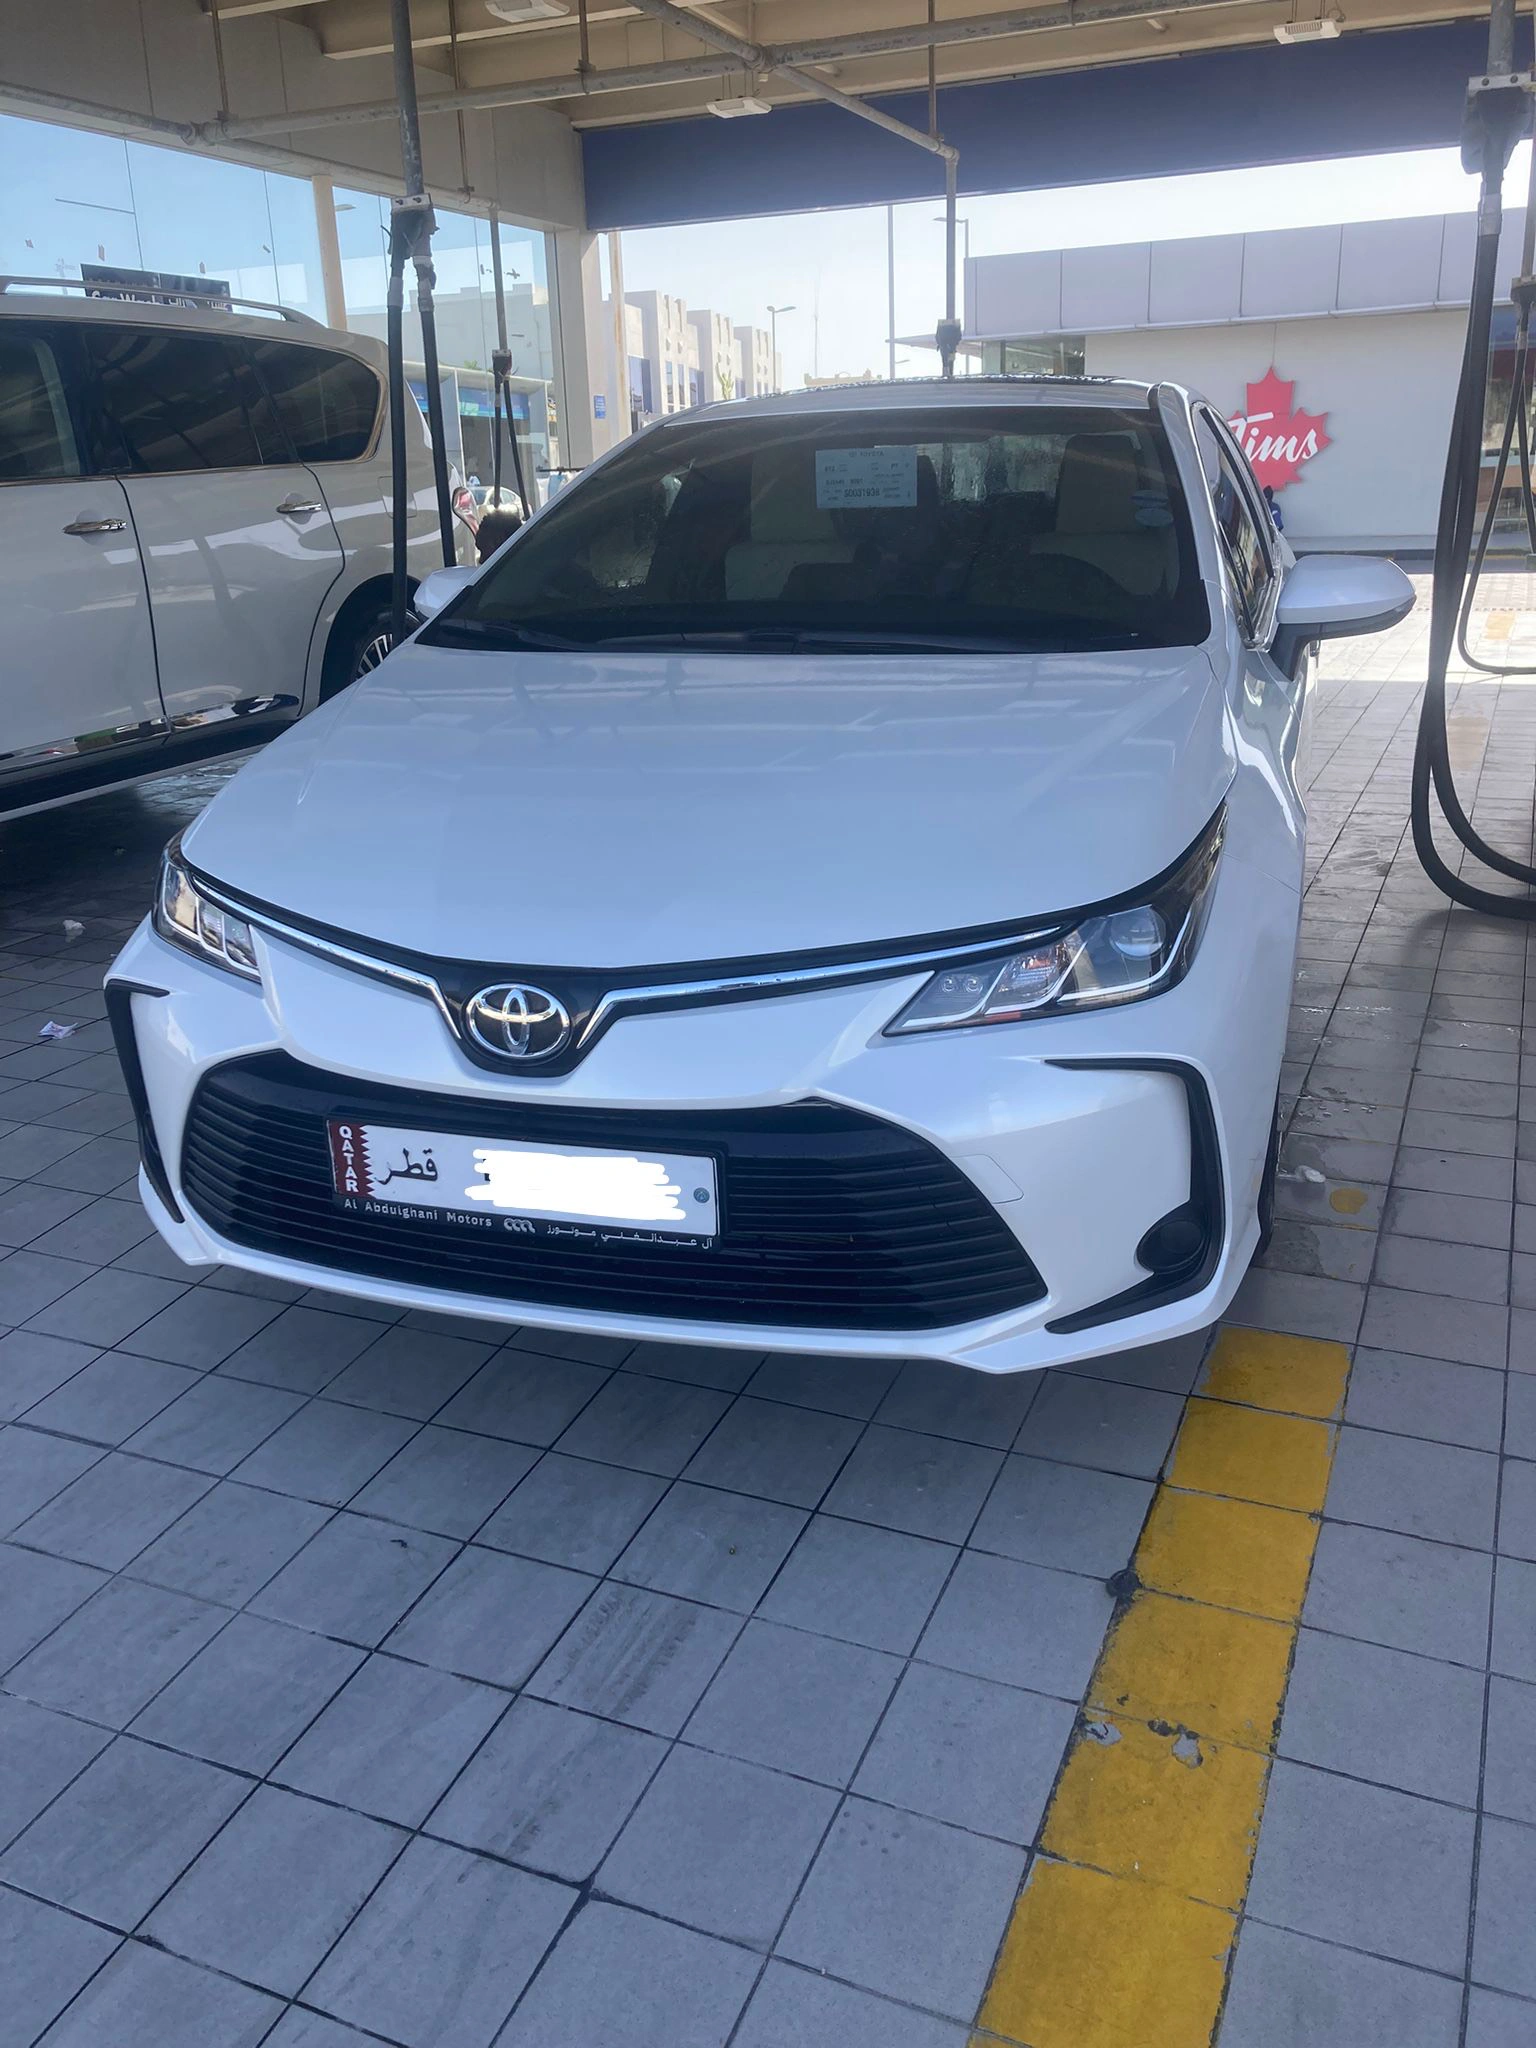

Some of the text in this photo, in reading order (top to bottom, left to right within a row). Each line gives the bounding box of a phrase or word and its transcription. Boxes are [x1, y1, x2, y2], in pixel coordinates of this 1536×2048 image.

[338, 1125, 359, 1193] QATAR
[374, 1147, 438, 1185] قطر
[344, 1198, 493, 1227] Al Abdulghani Motors
[547, 1223, 597, 1237] موتورز
